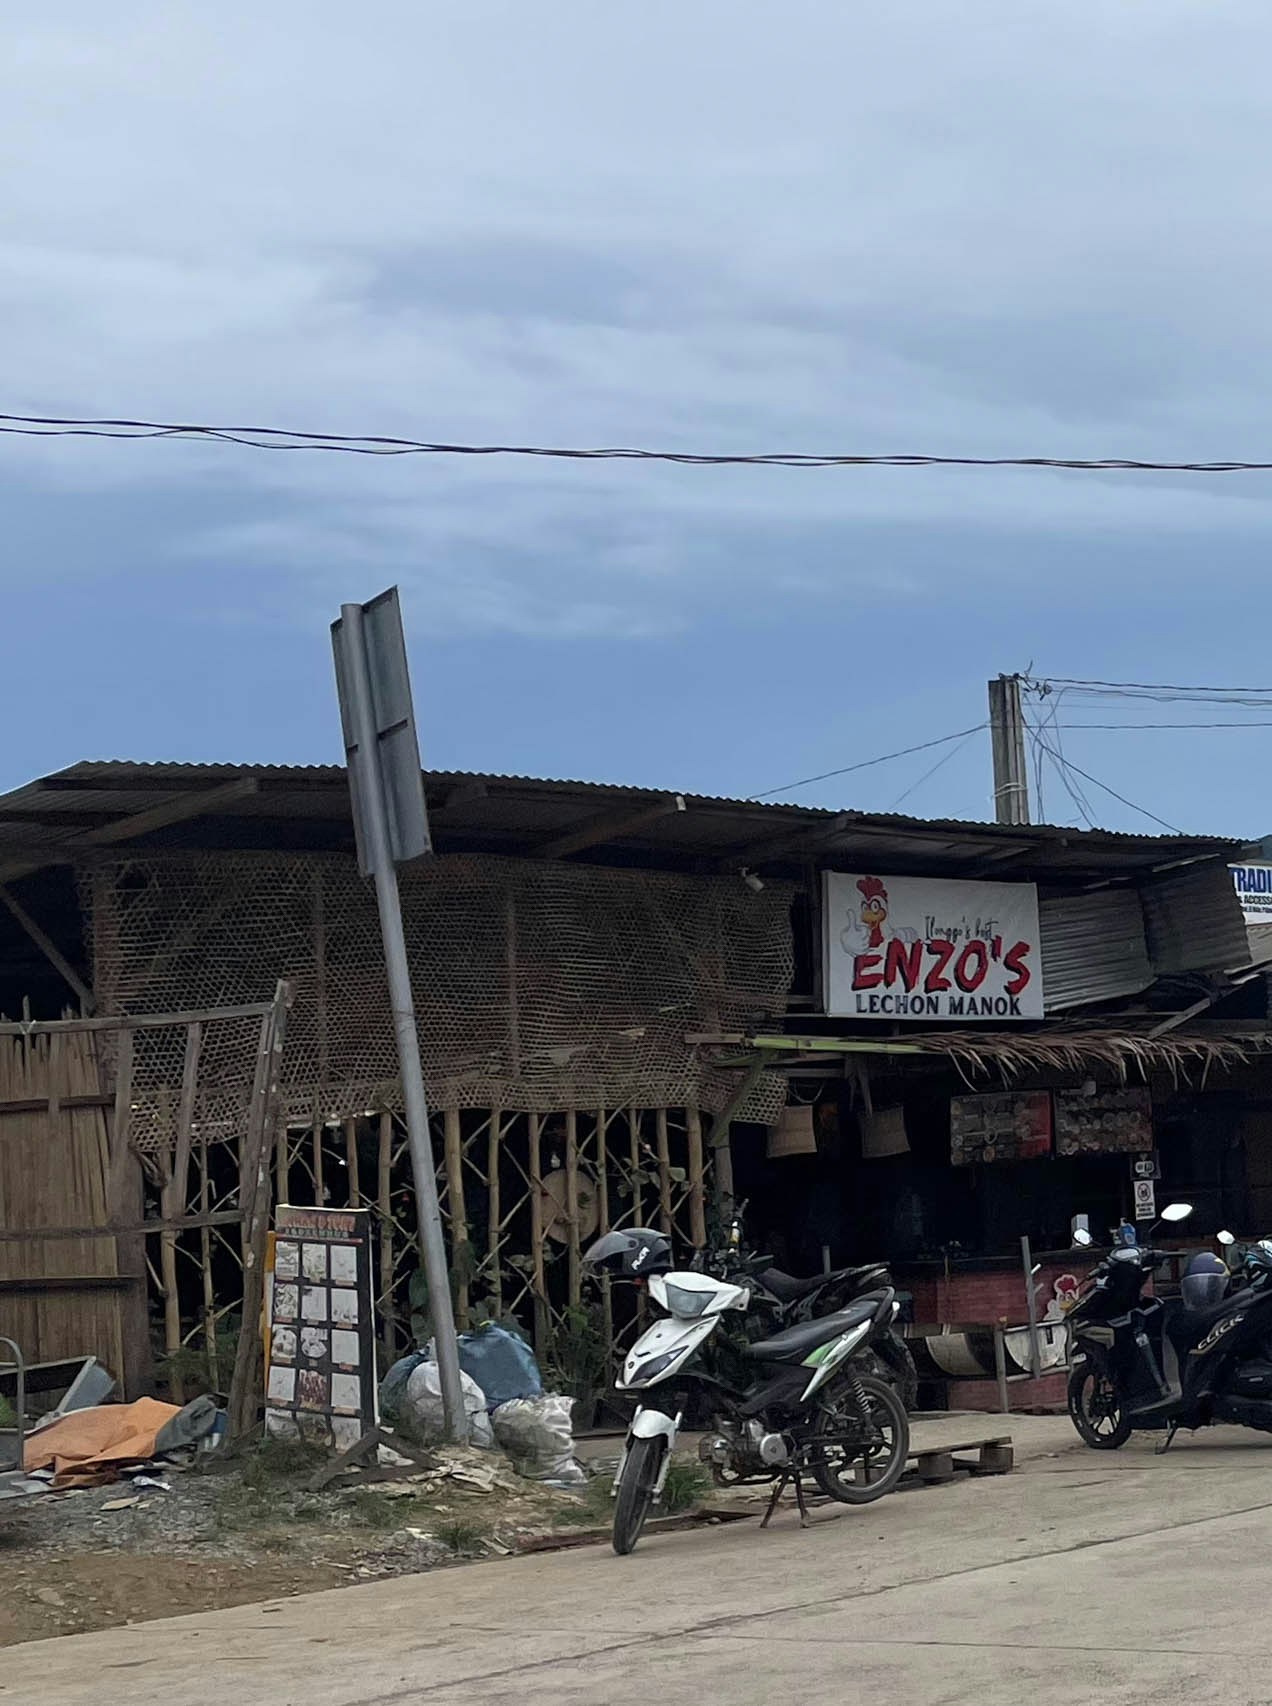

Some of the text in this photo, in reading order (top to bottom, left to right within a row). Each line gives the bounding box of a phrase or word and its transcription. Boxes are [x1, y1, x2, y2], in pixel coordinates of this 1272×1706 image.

[851, 935, 1031, 995] ENZO'S
[855, 993, 1022, 1016] LECHON MANOK
